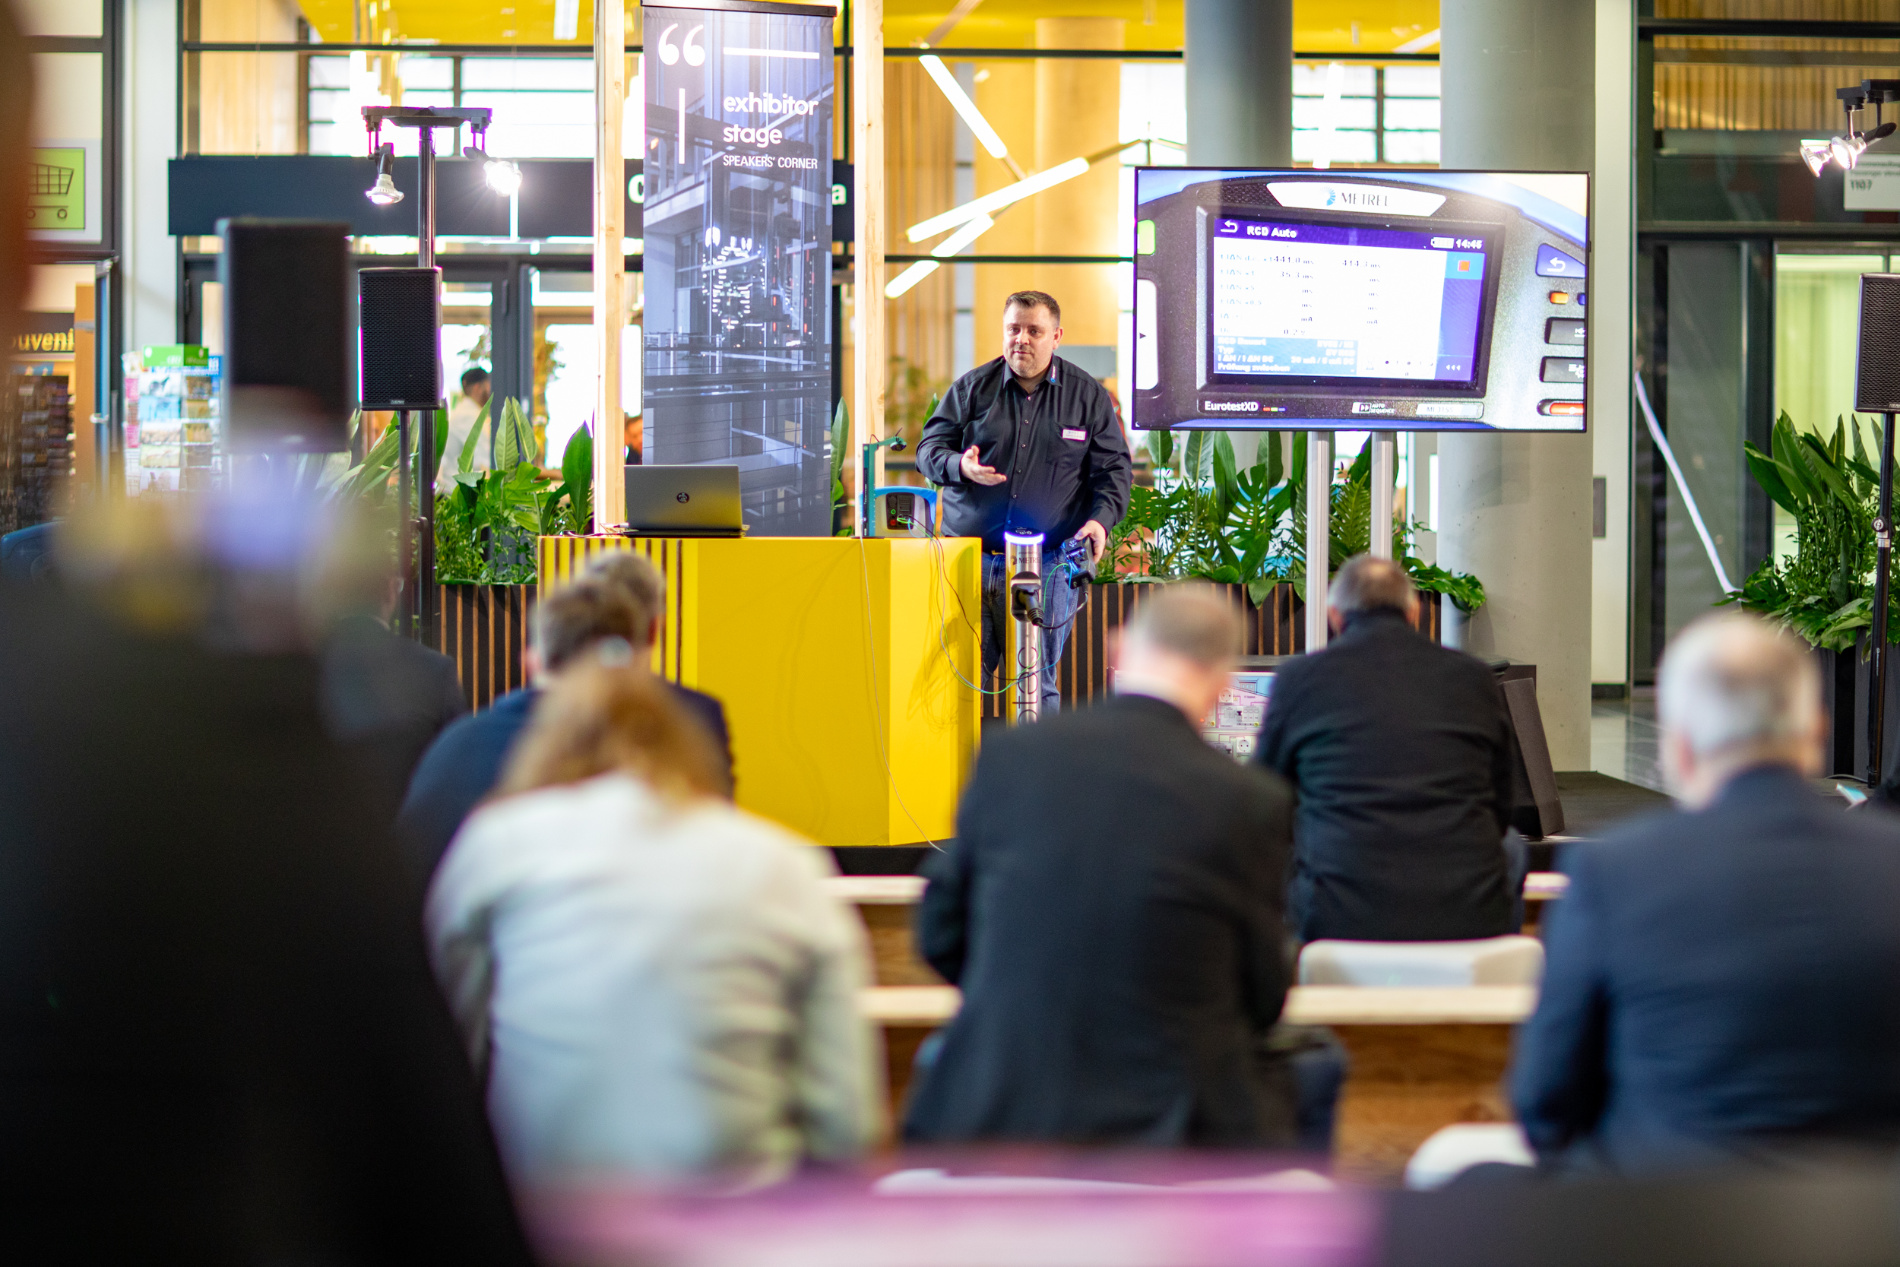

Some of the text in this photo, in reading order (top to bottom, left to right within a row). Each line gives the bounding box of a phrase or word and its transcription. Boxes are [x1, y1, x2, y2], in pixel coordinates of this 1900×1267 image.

[723, 92, 819, 116] exhibitor
[723, 124, 783, 148] stage
[777, 157, 818, 169] CORNER
[1246, 226, 1297, 238] RCD Auto
[12, 328, 75, 351] uveni
[1204, 401, 1259, 412] EurotestXD
